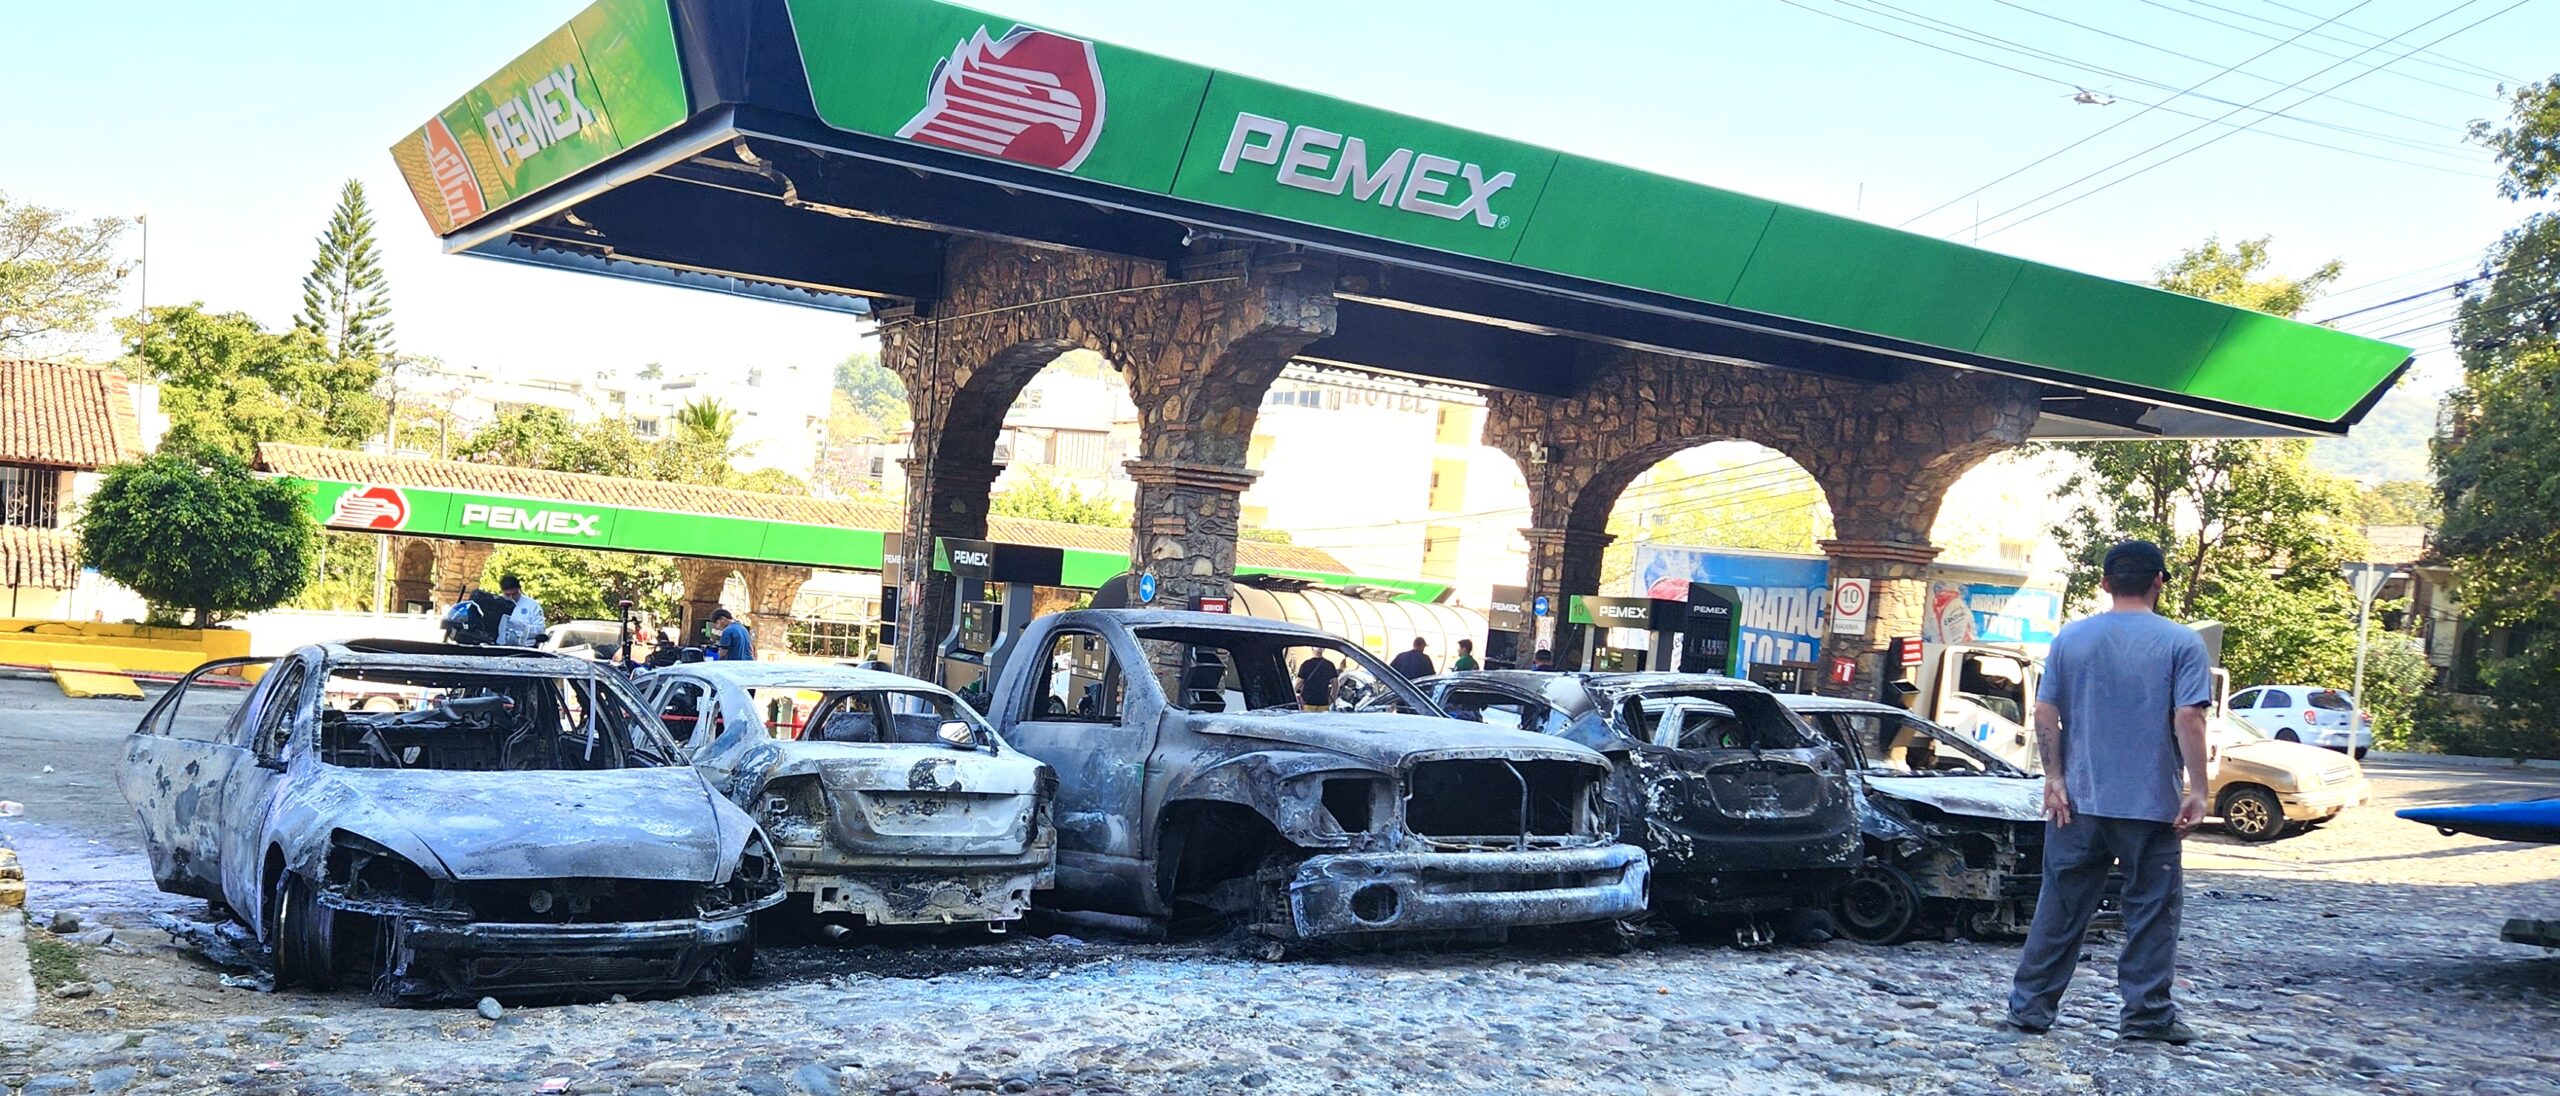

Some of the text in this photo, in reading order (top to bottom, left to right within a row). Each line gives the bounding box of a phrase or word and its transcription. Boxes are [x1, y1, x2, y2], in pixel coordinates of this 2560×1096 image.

[483, 63, 597, 168] PEMEX
[1218, 111, 1516, 228] PEMEX
[1345, 388, 1429, 415] HOTEL
[461, 503, 601, 537] PEMEX
[953, 550, 989, 567] PEMEX
[1491, 602, 1521, 613] PEMEX
[1842, 589, 1859, 604] 10
[1573, 604, 1584, 616] 10
[1599, 605, 1647, 619] PEMEX
[1693, 605, 1728, 615] PEMEX
[1736, 586, 1827, 638] DRATAC
[1742, 632, 1811, 672] TOTA
